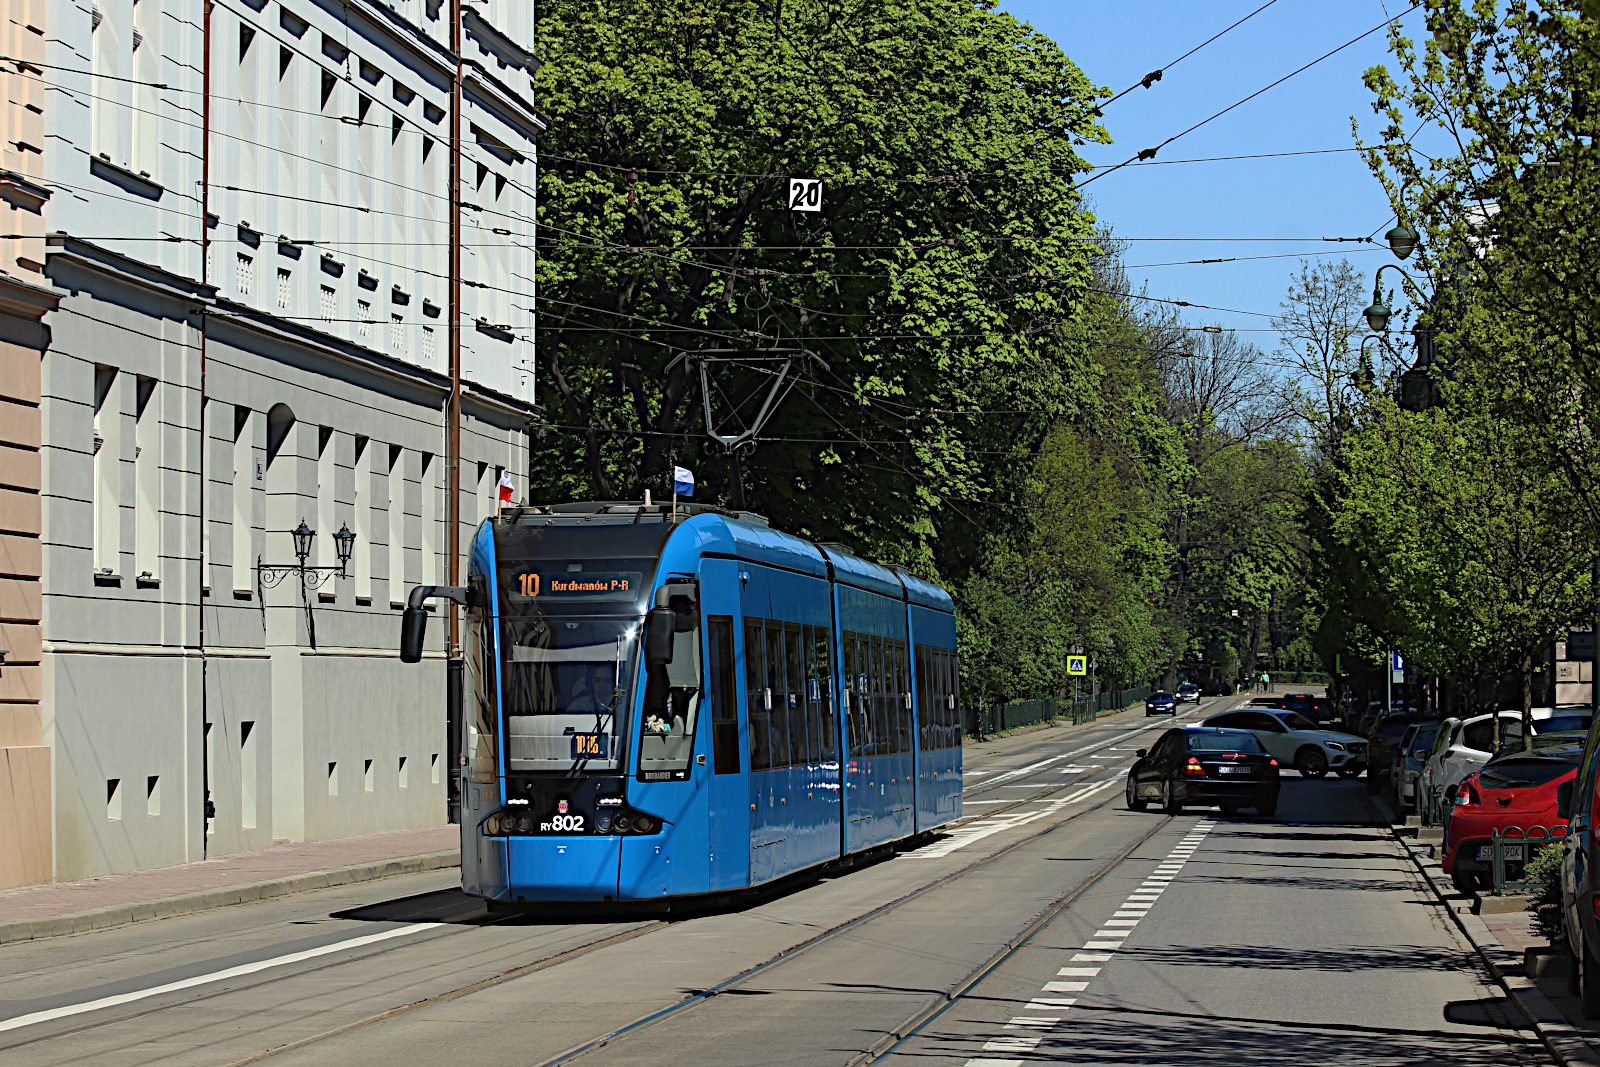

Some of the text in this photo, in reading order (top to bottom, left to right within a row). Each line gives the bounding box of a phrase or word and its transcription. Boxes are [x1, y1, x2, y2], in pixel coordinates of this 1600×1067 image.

[792, 182, 819, 207] 20
[519, 574, 540, 596] 10
[551, 580, 608, 591] Kurdwanów
